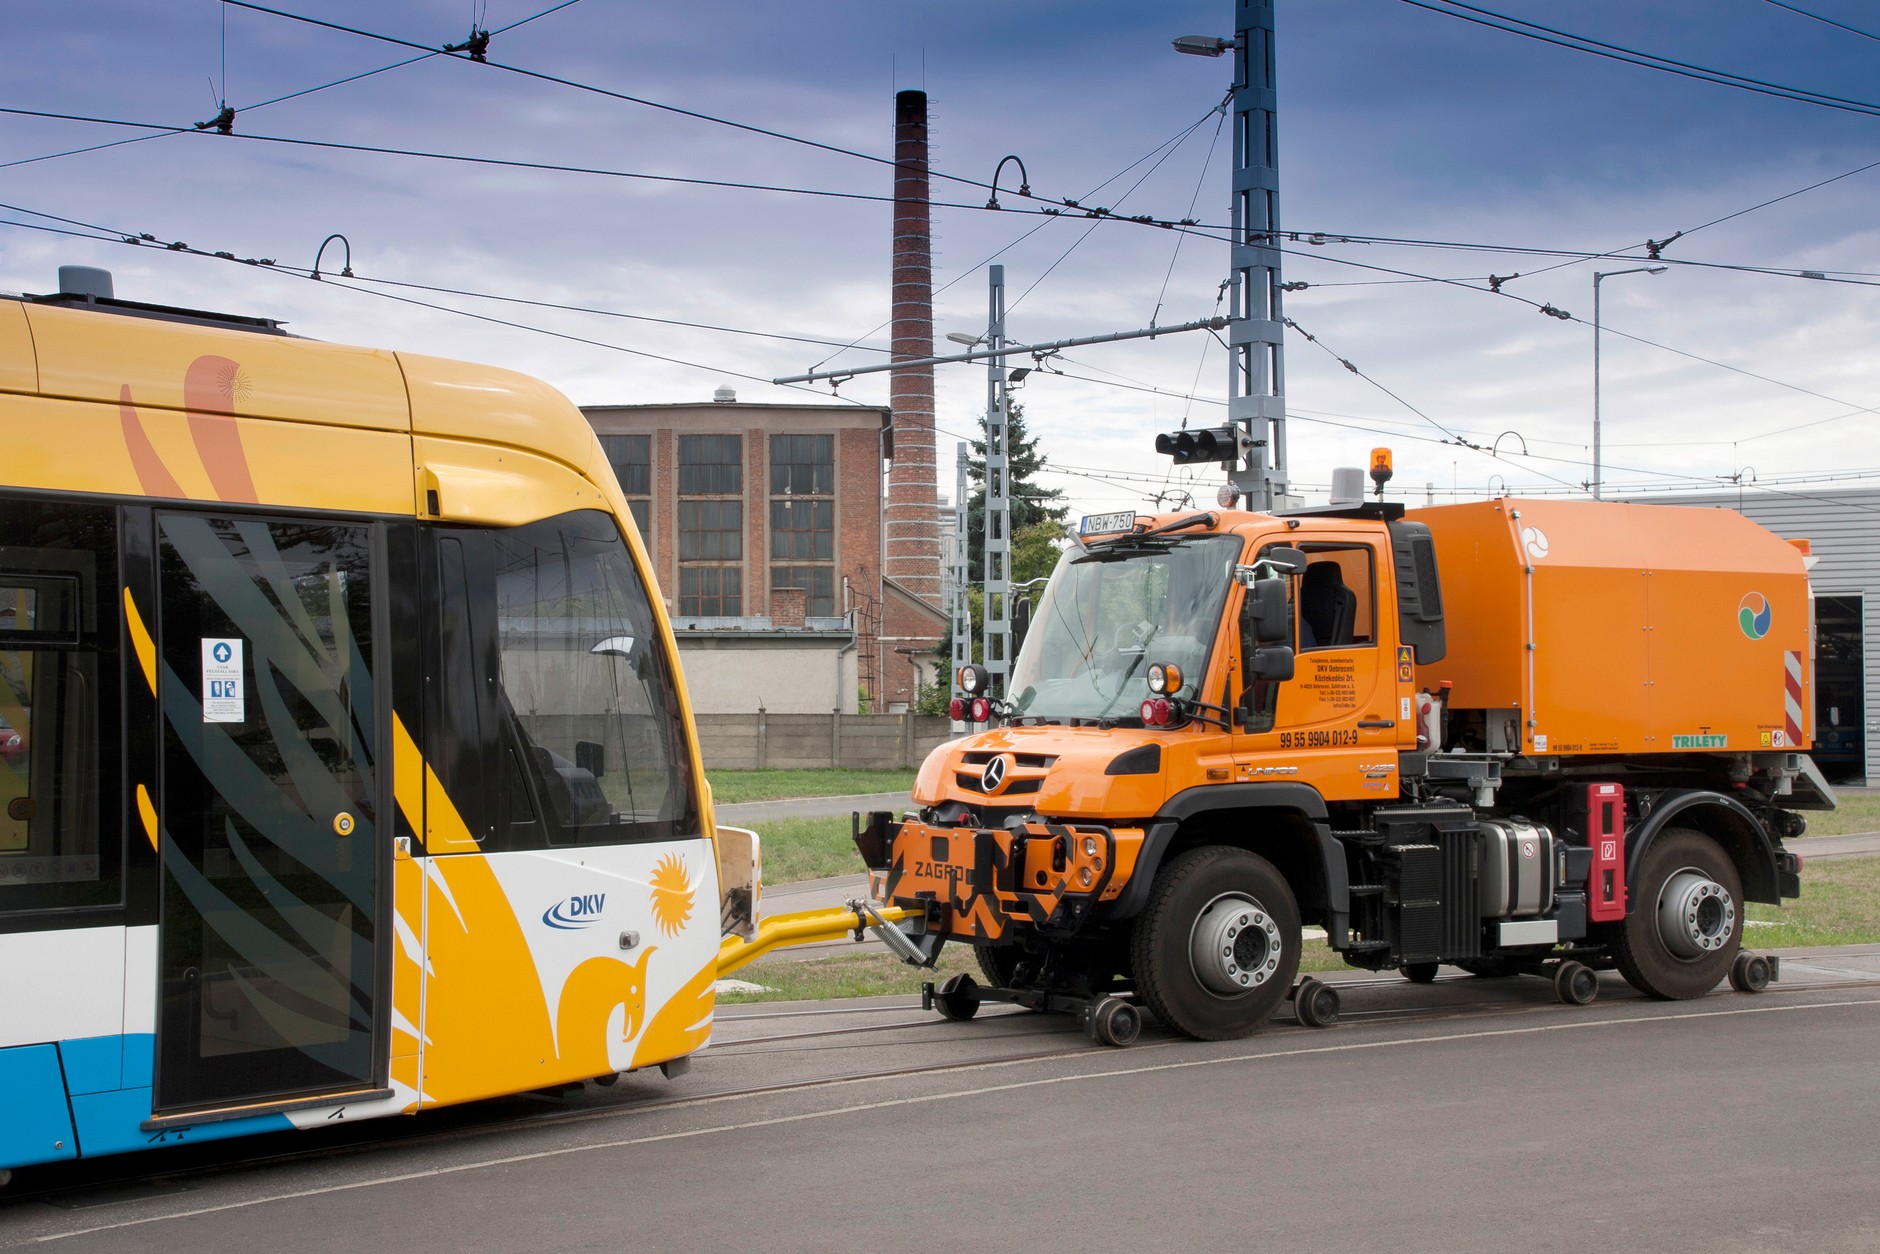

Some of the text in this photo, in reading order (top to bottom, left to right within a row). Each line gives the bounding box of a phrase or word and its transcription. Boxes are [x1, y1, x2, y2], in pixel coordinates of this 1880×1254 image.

[1088, 514, 1132, 531] NBW-750
[1314, 674, 1355, 682] Közlekedési Zrt.
[1280, 729, 1358, 748] 99 55 9904 012-9
[1673, 735, 1727, 748] TRILETY
[1248, 766, 1298, 776] UNIMOG
[571, 893, 606, 917] DKV
